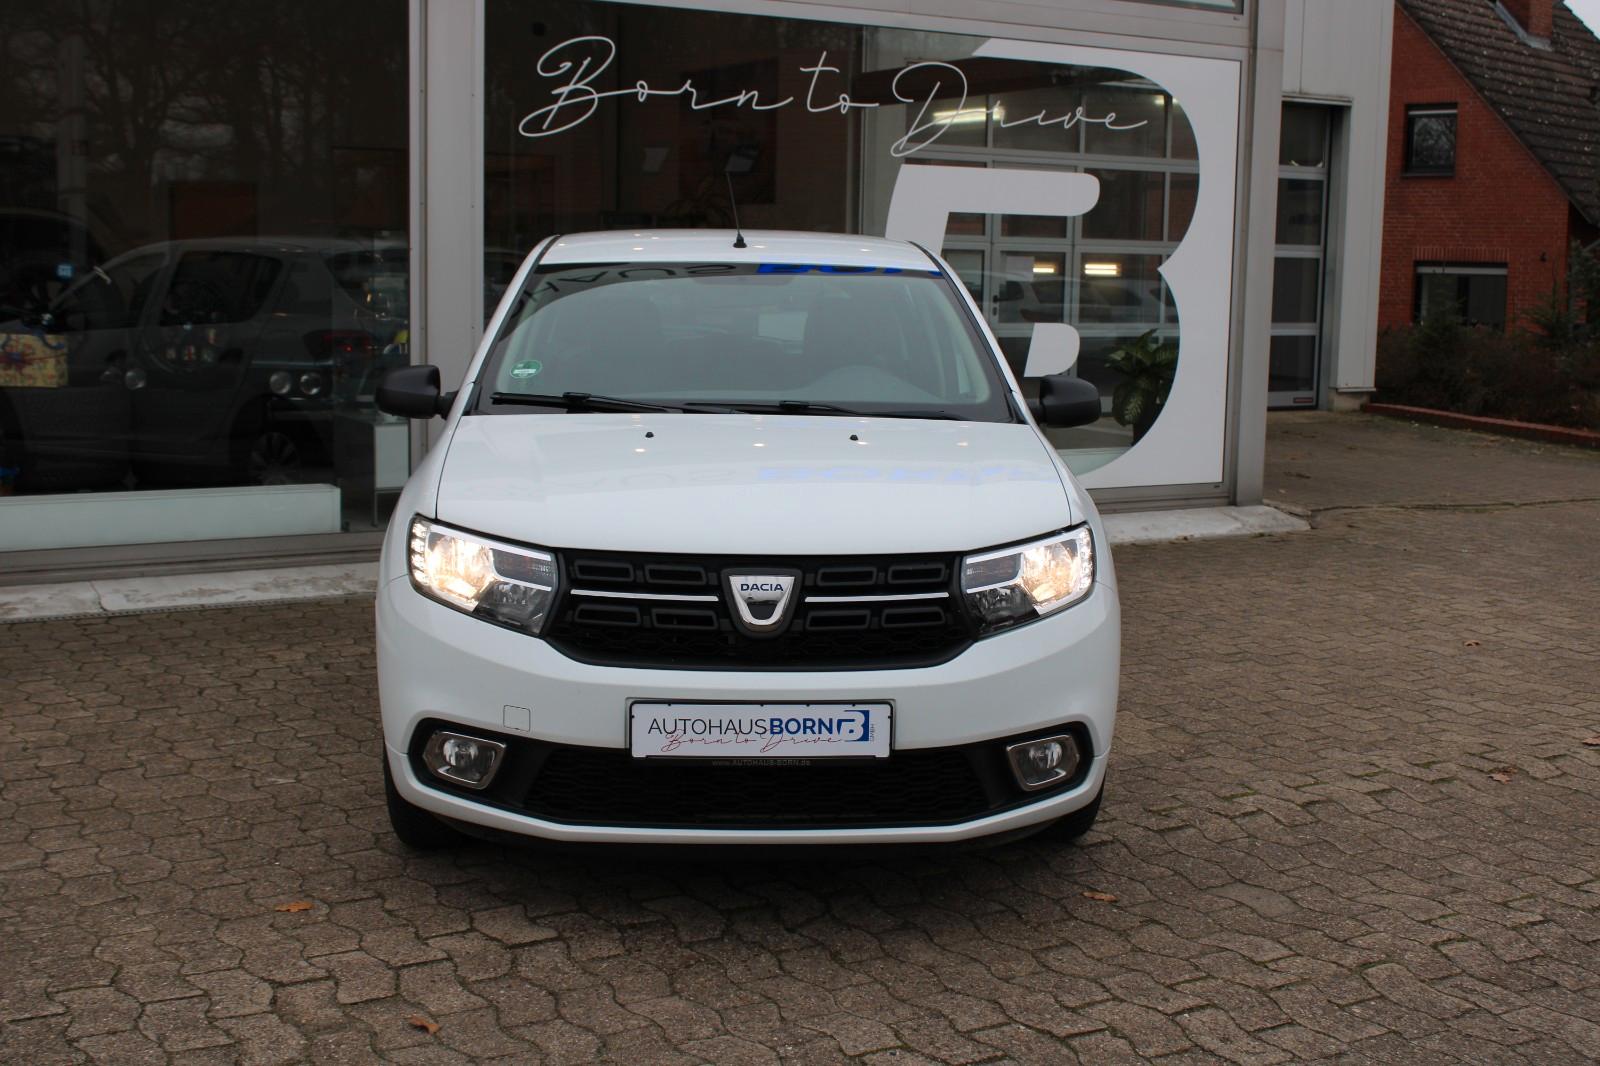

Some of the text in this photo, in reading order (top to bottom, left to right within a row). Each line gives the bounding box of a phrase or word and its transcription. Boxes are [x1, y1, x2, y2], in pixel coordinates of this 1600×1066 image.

[519, 36, 1148, 157] Born to Drive
[740, 583, 784, 592] DACIA
[661, 729, 733, 752] Born
